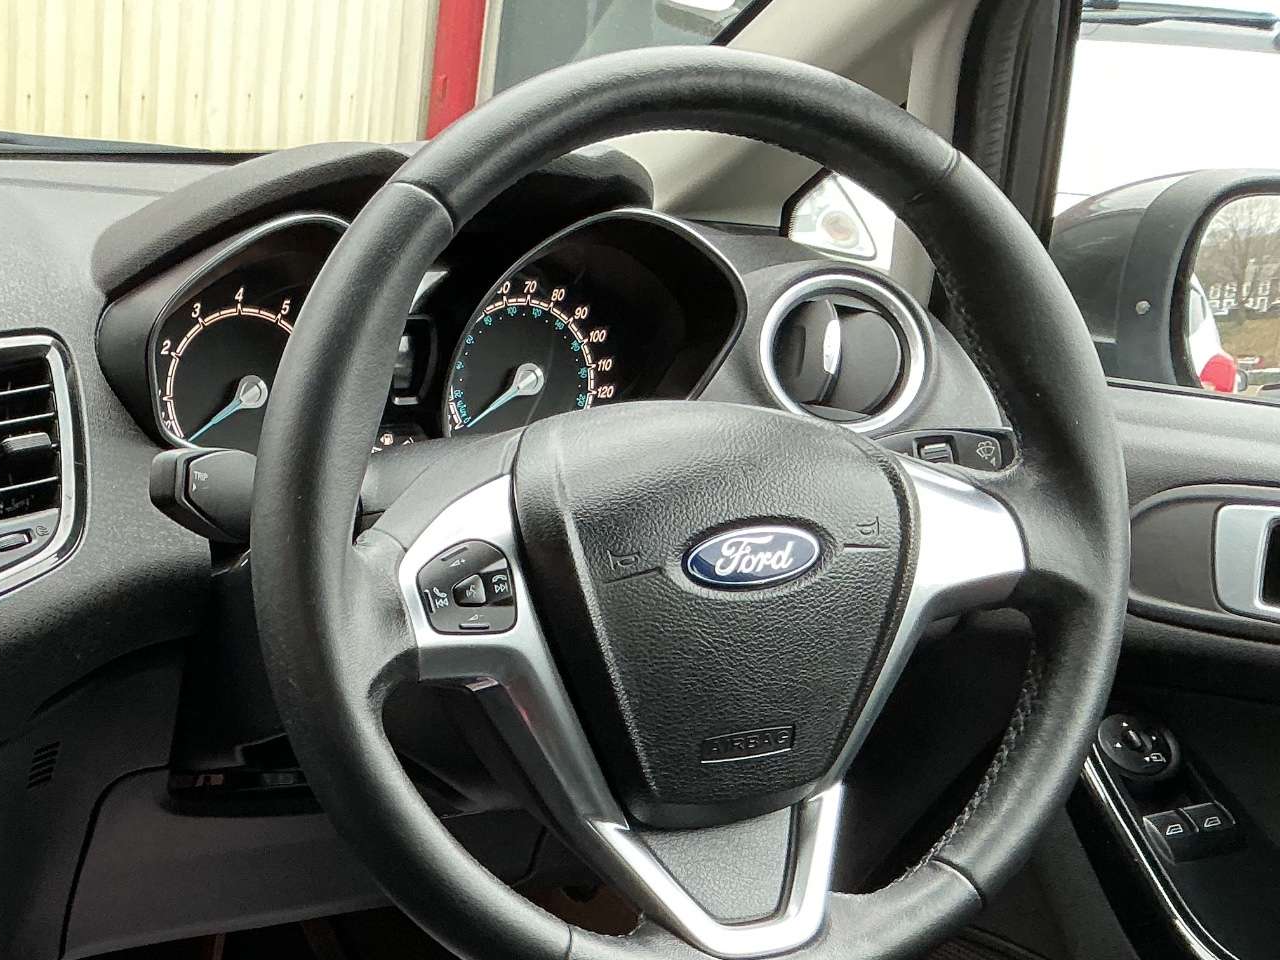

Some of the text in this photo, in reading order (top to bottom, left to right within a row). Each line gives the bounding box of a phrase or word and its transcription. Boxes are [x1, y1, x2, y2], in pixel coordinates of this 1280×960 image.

[523, 280, 537, 293] 70
[234, 287, 245, 302] 4
[551, 288, 565, 301] 80
[191, 302, 201, 319] 3
[280, 299, 291, 315] 5
[574, 306, 588, 319] 90
[589, 329, 607, 342] 100
[160, 339, 171, 355] 2
[597, 358, 612, 371] 110
[597, 385, 614, 398] 120
[715, 535, 795, 576] Ford
[711, 729, 789, 753] AIRBAG
